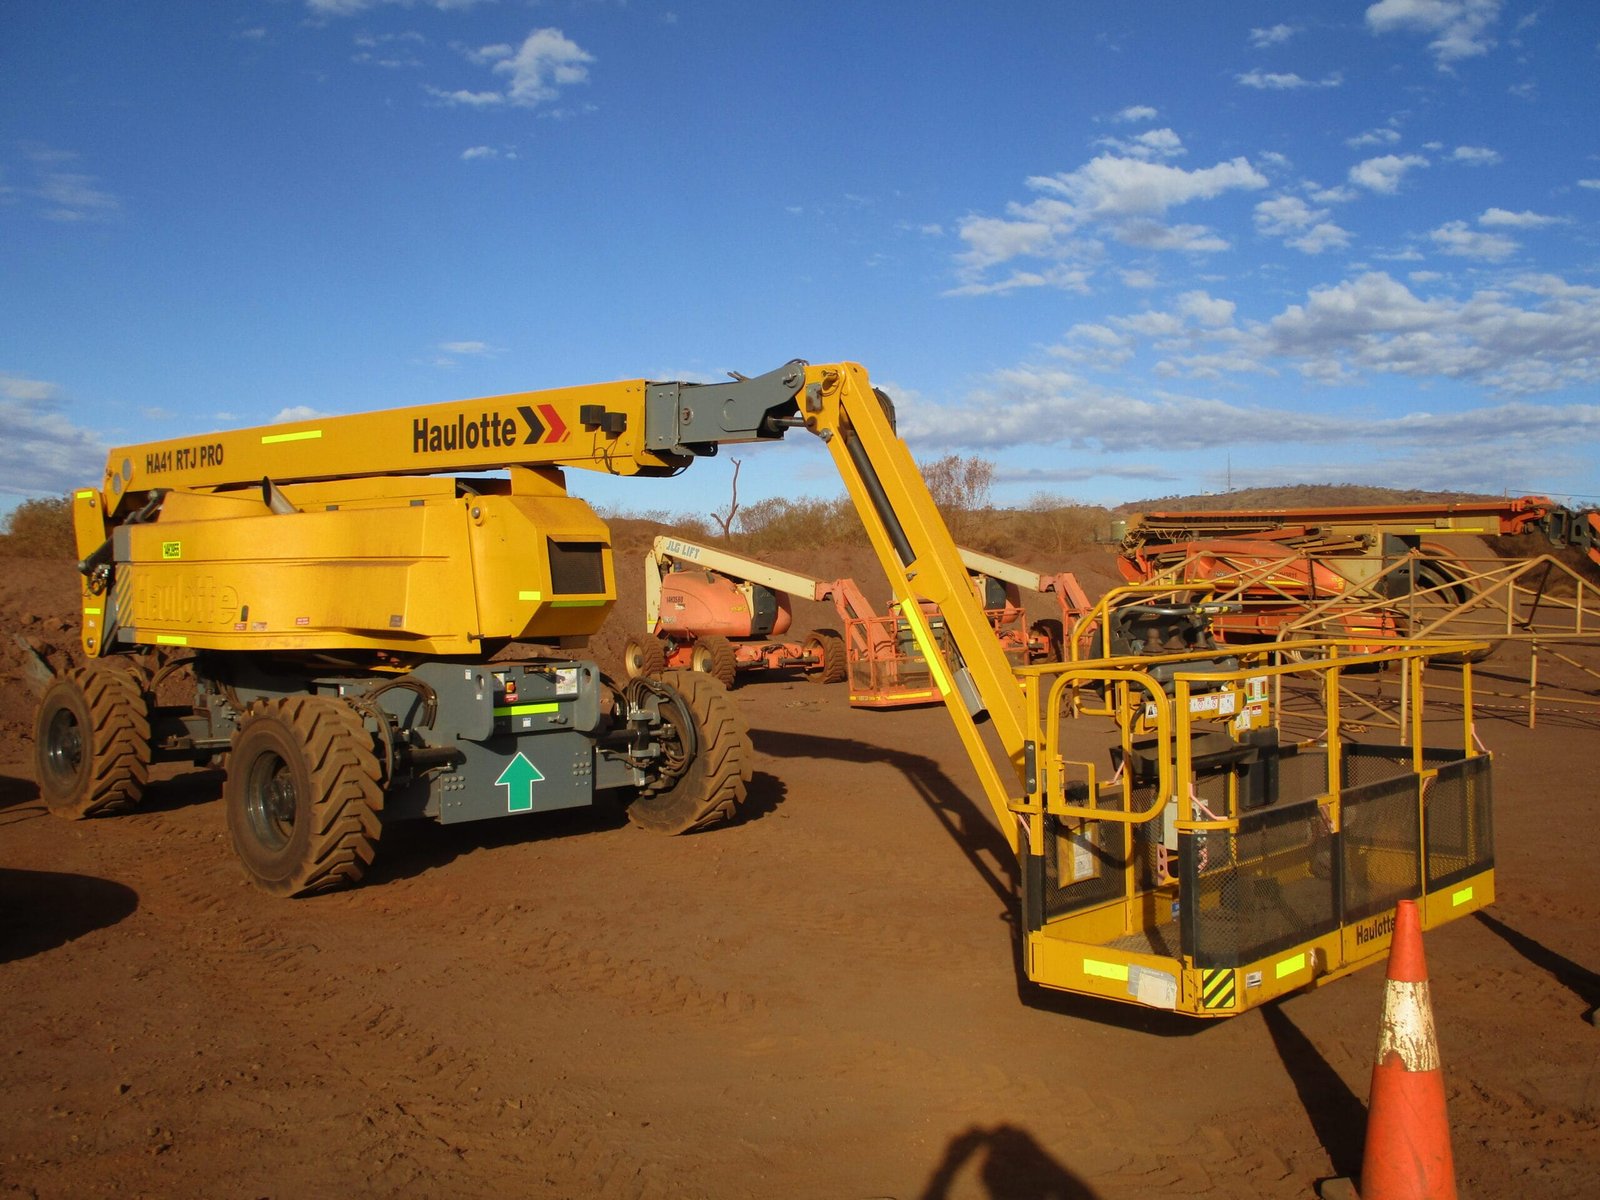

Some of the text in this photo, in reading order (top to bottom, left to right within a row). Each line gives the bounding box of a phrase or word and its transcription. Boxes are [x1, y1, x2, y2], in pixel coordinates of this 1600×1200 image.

[413, 411, 517, 453] Haulotte
[146, 443, 224, 474] HA41 RTJ PRO
[666, 540, 700, 559] JLG LIFT
[135, 572, 239, 625] Haulotte
[1356, 914, 1396, 946] Haulotte
